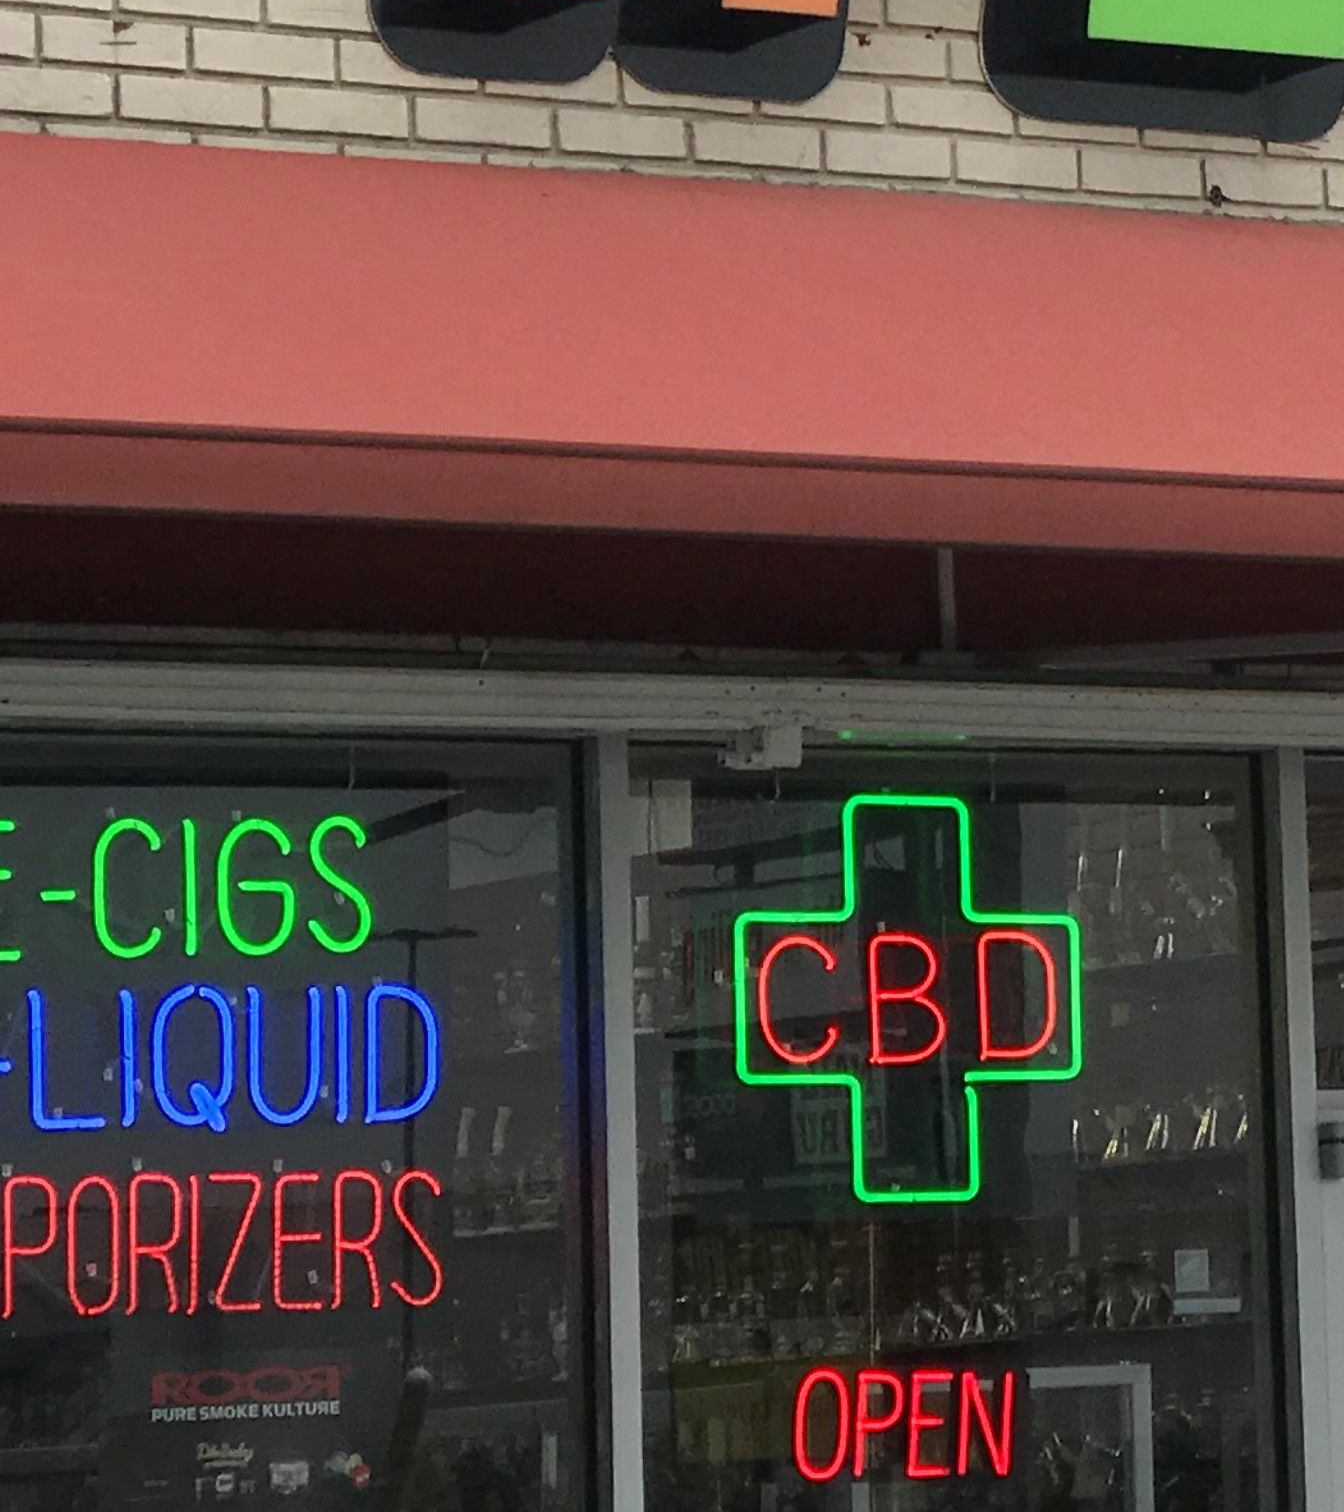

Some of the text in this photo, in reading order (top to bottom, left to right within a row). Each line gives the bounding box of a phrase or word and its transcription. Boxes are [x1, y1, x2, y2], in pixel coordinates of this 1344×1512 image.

[758, 931, 1057, 1065] CBD
[151, 1399, 341, 1423] PURE SMOKE KULTURE
[794, 1368, 1014, 1480] OPEN
